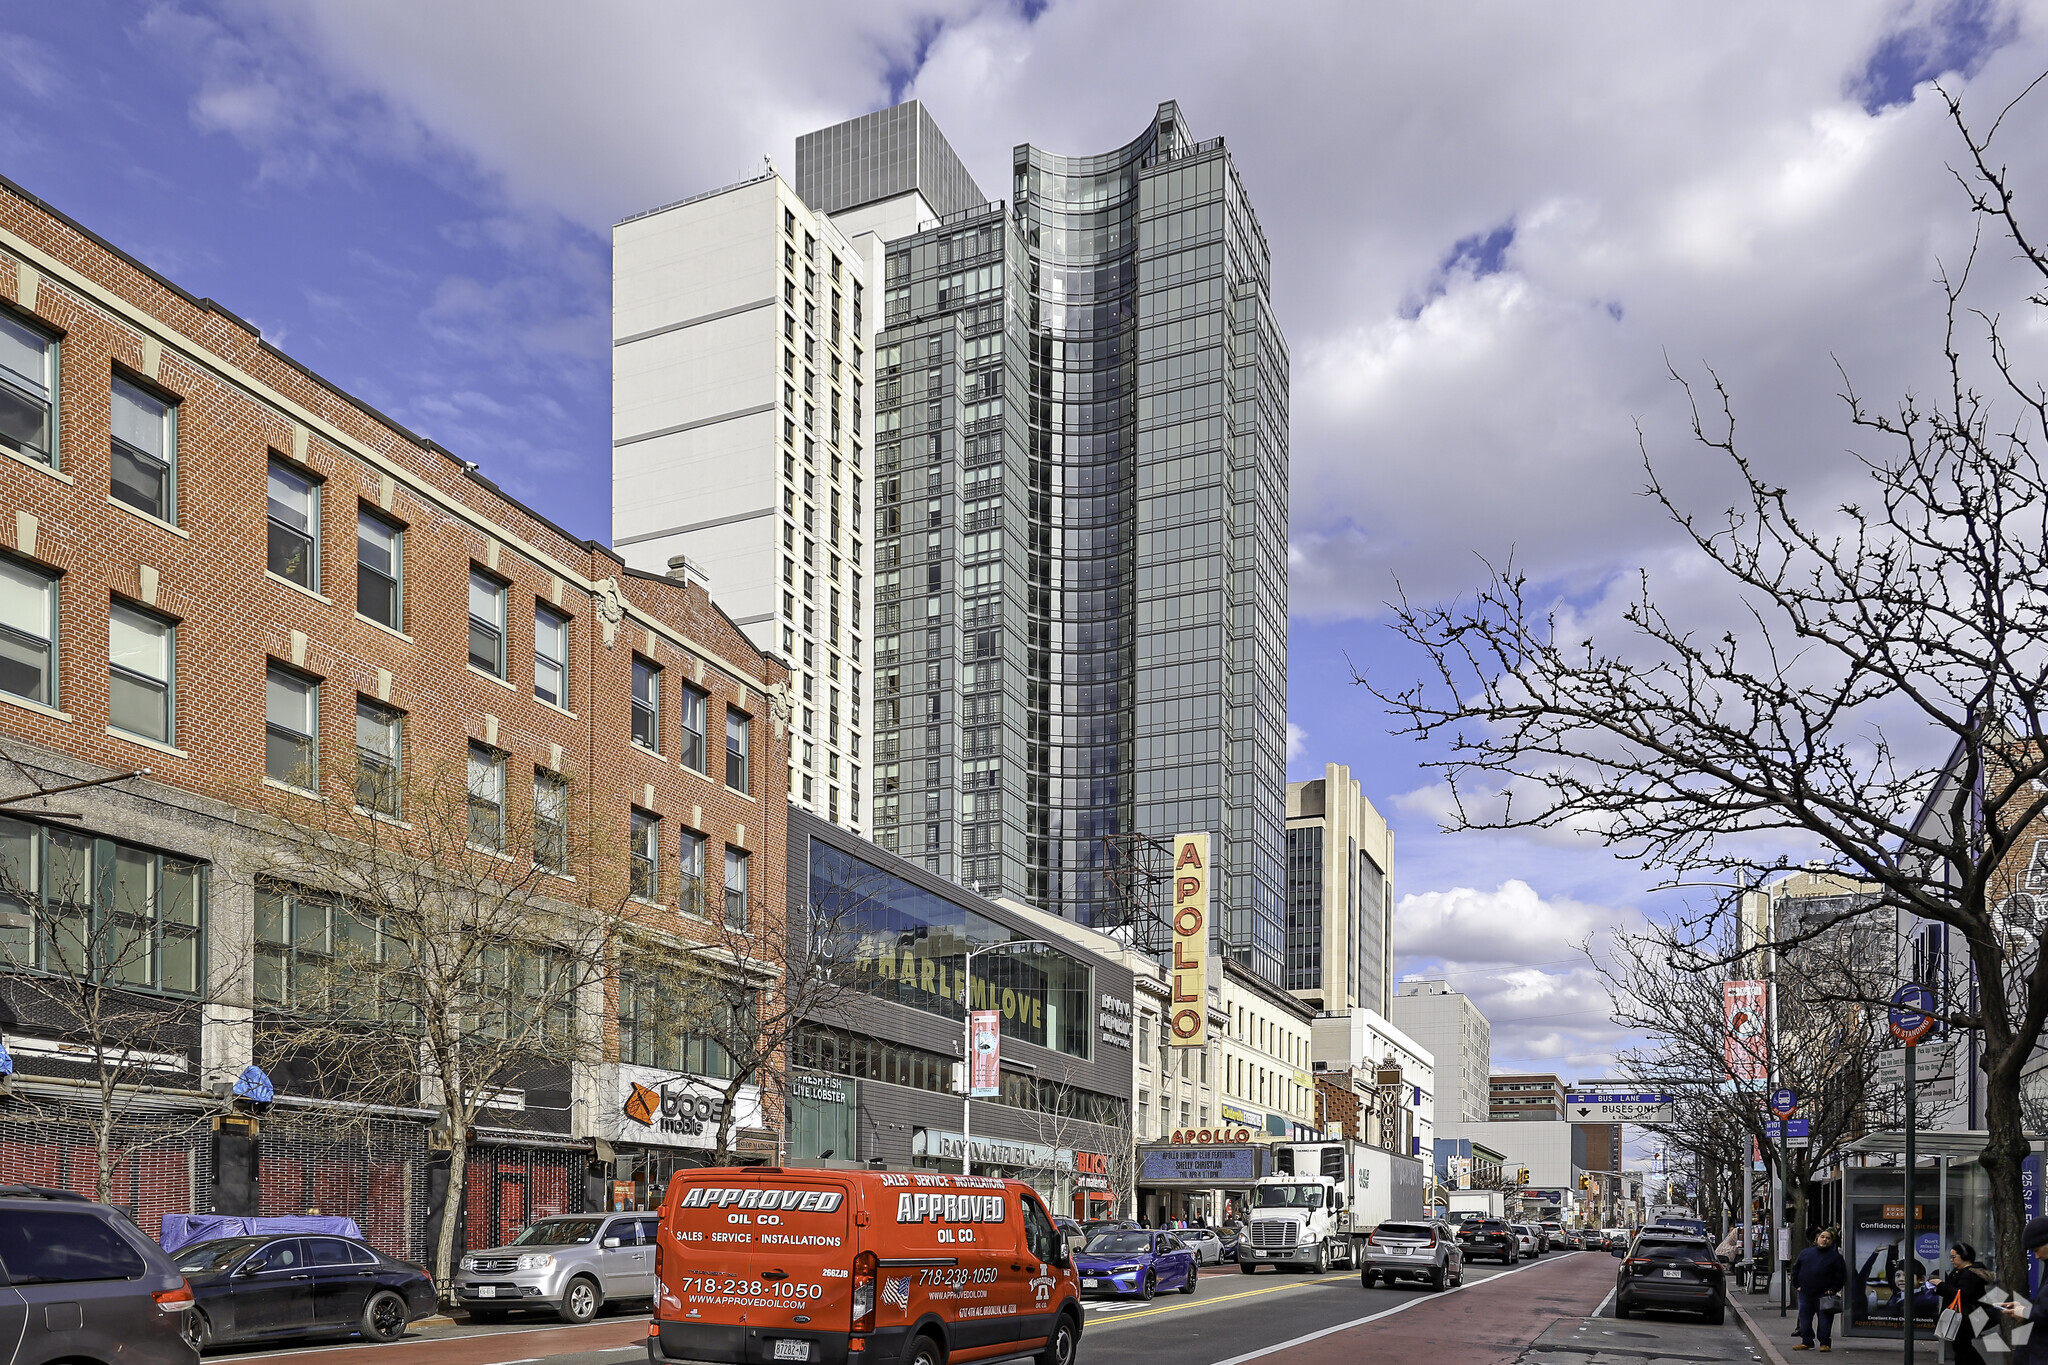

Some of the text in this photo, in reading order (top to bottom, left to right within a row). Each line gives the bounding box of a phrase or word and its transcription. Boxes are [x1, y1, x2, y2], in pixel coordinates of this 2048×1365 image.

[1172, 842, 1203, 1039] APOLLO
[1892, 1019, 1930, 1038] NO STANDING
[1880, 1069, 1898, 1077] Topview
[1602, 1105, 1634, 1113] BUSES
[660, 1117, 704, 1137] mobile
[1171, 1129, 1251, 1144] APOLLO
[941, 1138, 1035, 1166] BANNA REPUBLIC
[1175, 1160, 1223, 1170] SHELLY CHRISTIAN
[880, 1174, 1006, 1190] SALES SERVICE INSTALLATIONS
[1078, 1177, 1086, 1187] art
[2022, 1170, 2033, 1186] 125
[680, 1188, 844, 1213] APPROVED
[2023, 1190, 2033, 1200] St
[896, 1192, 1006, 1224] APPROVED
[727, 1213, 784, 1226] OIL CO.
[676, 1231, 841, 1247] SALES SERVICE INSTALLATIONS
[937, 1228, 977, 1243] OIL CO.
[822, 1268, 848, 1278] 266ZJB
[688, 1295, 806, 1310] WWW.APPROVEDOIL.COM
